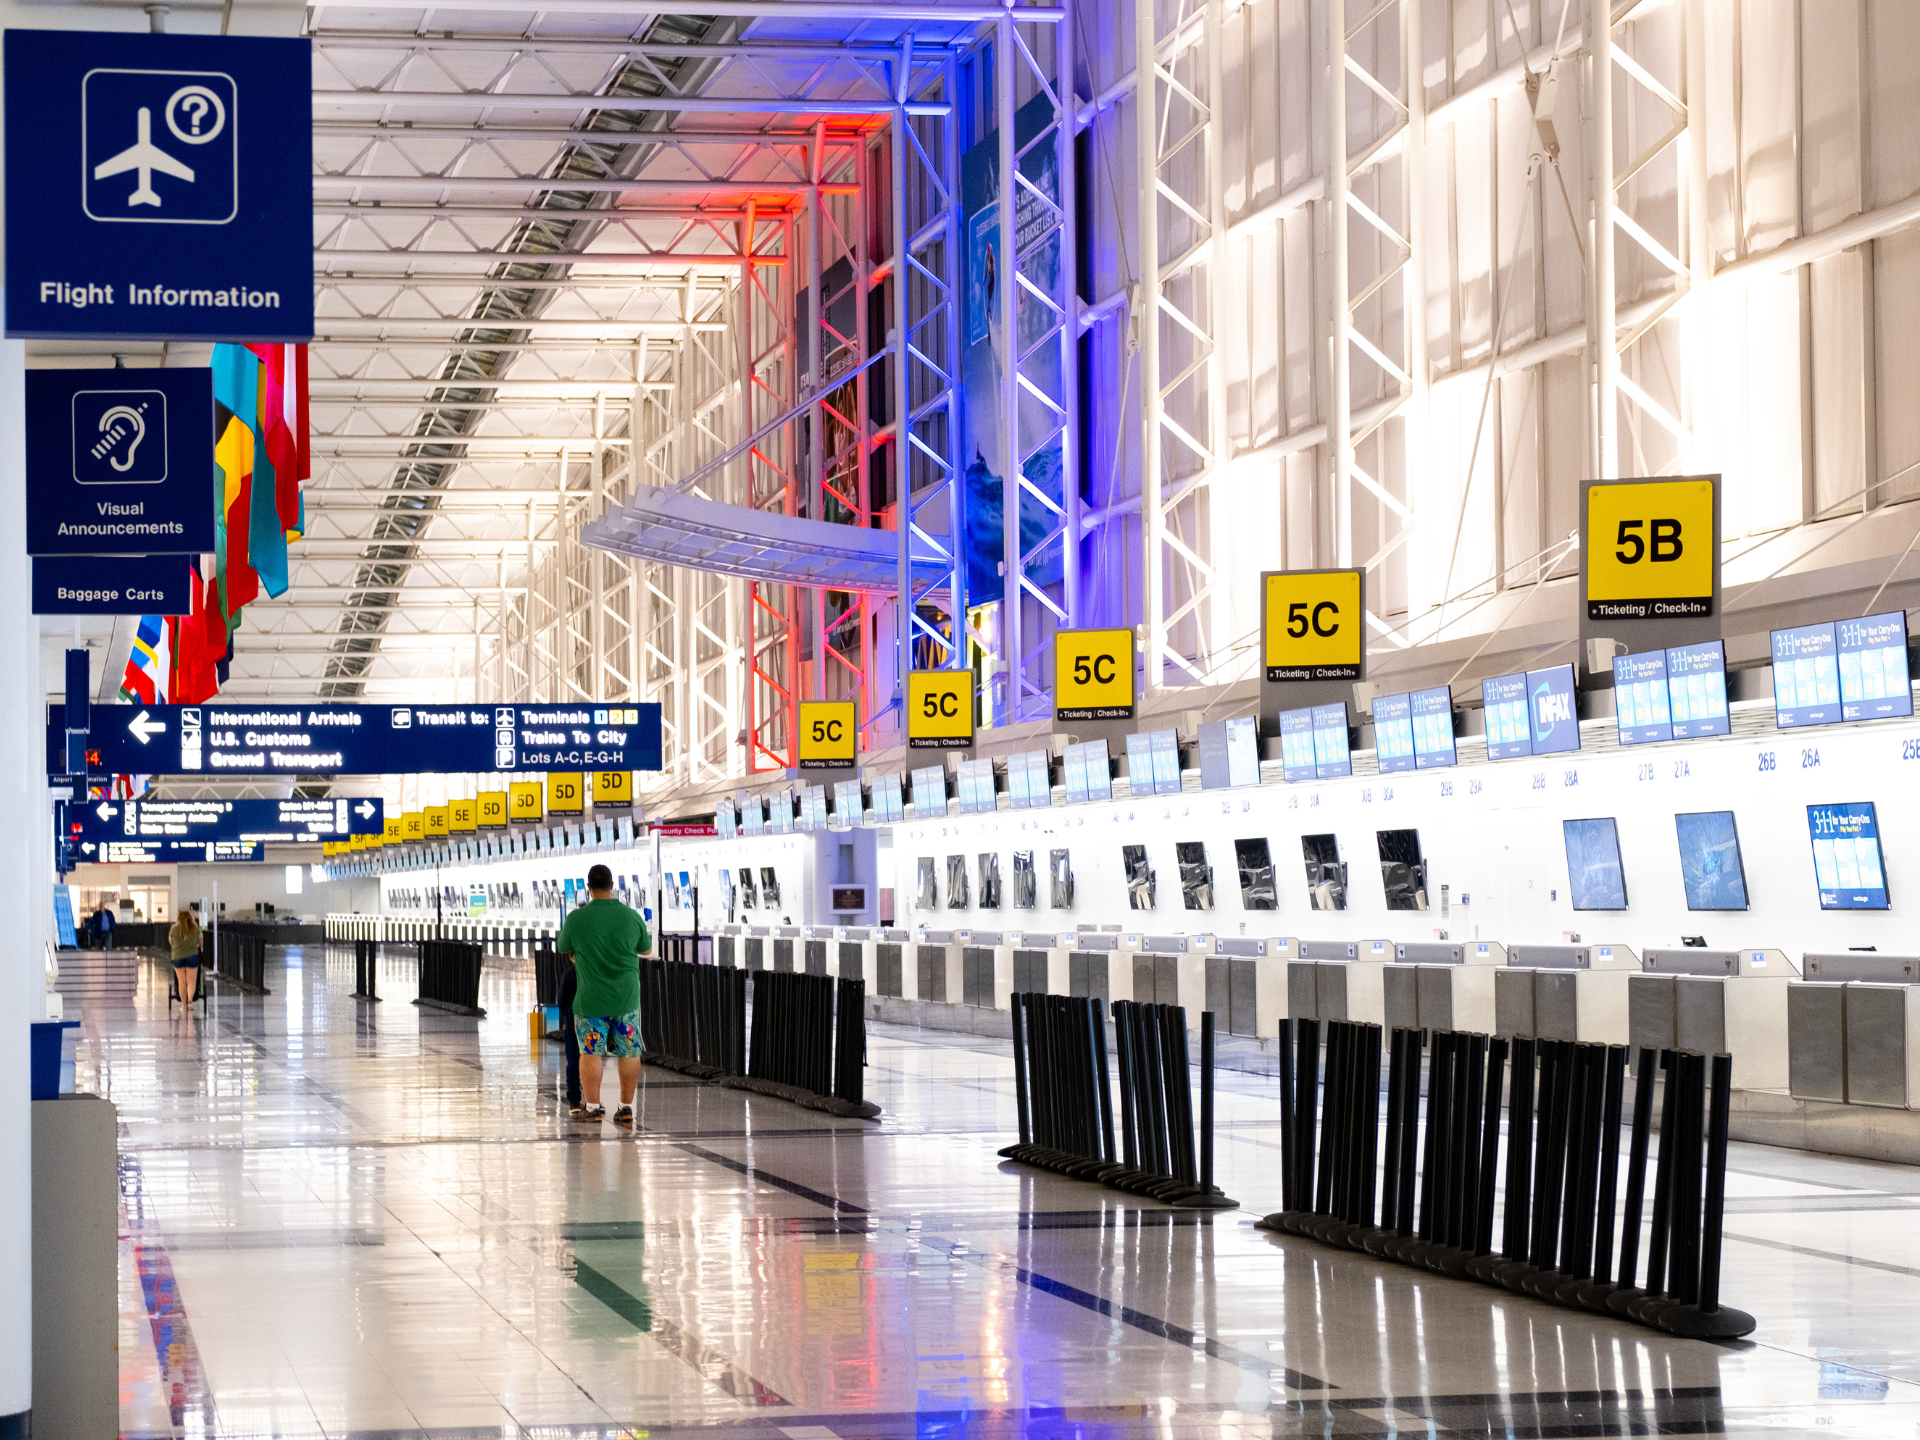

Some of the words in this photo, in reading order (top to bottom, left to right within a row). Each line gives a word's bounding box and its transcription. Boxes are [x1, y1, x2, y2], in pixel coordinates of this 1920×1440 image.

[40, 282, 114, 308] Flight
[129, 284, 280, 308] Information
[97, 502, 144, 516] Visual
[57, 521, 184, 536] Announcements
[1615, 518, 1684, 565] 5B
[58, 587, 119, 601] Baggage
[125, 588, 164, 601] Carts
[1598, 603, 1646, 618] Ticketing
[1654, 602, 1701, 615] Check-In
[1286, 601, 1340, 639] 5C
[1841, 622, 1862, 648] 3-1-1
[1868, 627, 1878, 637] Your
[1878, 623, 1901, 636] Carry-Ons
[1775, 632, 1796, 657] 3-1-1
[1801, 636, 1810, 646] Your
[1671, 650, 1689, 672] 3-1-1
[1692, 654, 1701, 663] Your
[1073, 655, 1116, 685] 5C
[1274, 669, 1310, 681] Ticketing
[1316, 668, 1352, 679] Check-In
[1617, 659, 1634, 680] 3-1-1
[923, 692, 958, 718] 5C
[1539, 693, 1571, 724] INFAX
[210, 711, 301, 726] International
[307, 711, 362, 726] Arrivals
[416, 711, 466, 725] Transit
[470, 711, 489, 725] to:
[521, 710, 590, 725] Terminals
[1063, 709, 1094, 720] Ticketing
[1098, 708, 1126, 718] Check-In
[210, 731, 240, 746] U.S.
[245, 731, 311, 746] Customs
[522, 731, 566, 745] Trains
[572, 731, 590, 744] To
[597, 730, 627, 746] City
[812, 720, 843, 742] 5C
[914, 739, 939, 748] Ticketing
[943, 738, 967, 747] Check-In
[210, 752, 265, 767] Ground
[270, 752, 343, 769] Transport
[522, 752, 551, 765] Lots
[804, 760, 825, 768] Ticketing
[1758, 752, 1776, 772] 26B
[1802, 748, 1821, 769] 26A
[1638, 763, 1654, 781] 27B
[1674, 760, 1691, 779] 27A
[601, 773, 623, 789] 5D
[1532, 773, 1546, 789] 28B
[1564, 769, 1579, 787] 28A
[555, 784, 575, 799] 5D
[1440, 781, 1453, 797] 29B
[1469, 779, 1482, 795] 29A
[517, 794, 535, 807] 5D
[455, 809, 470, 821] 5E
[483, 802, 500, 816] 5D
[407, 821, 420, 832] 5E
[430, 816, 444, 827] 5E
[1813, 810, 1835, 833] 3-1-1
[1839, 815, 1848, 825] Your
[1849, 814, 1871, 826] Carry-Ons
[660, 828, 682, 836] ecurity
